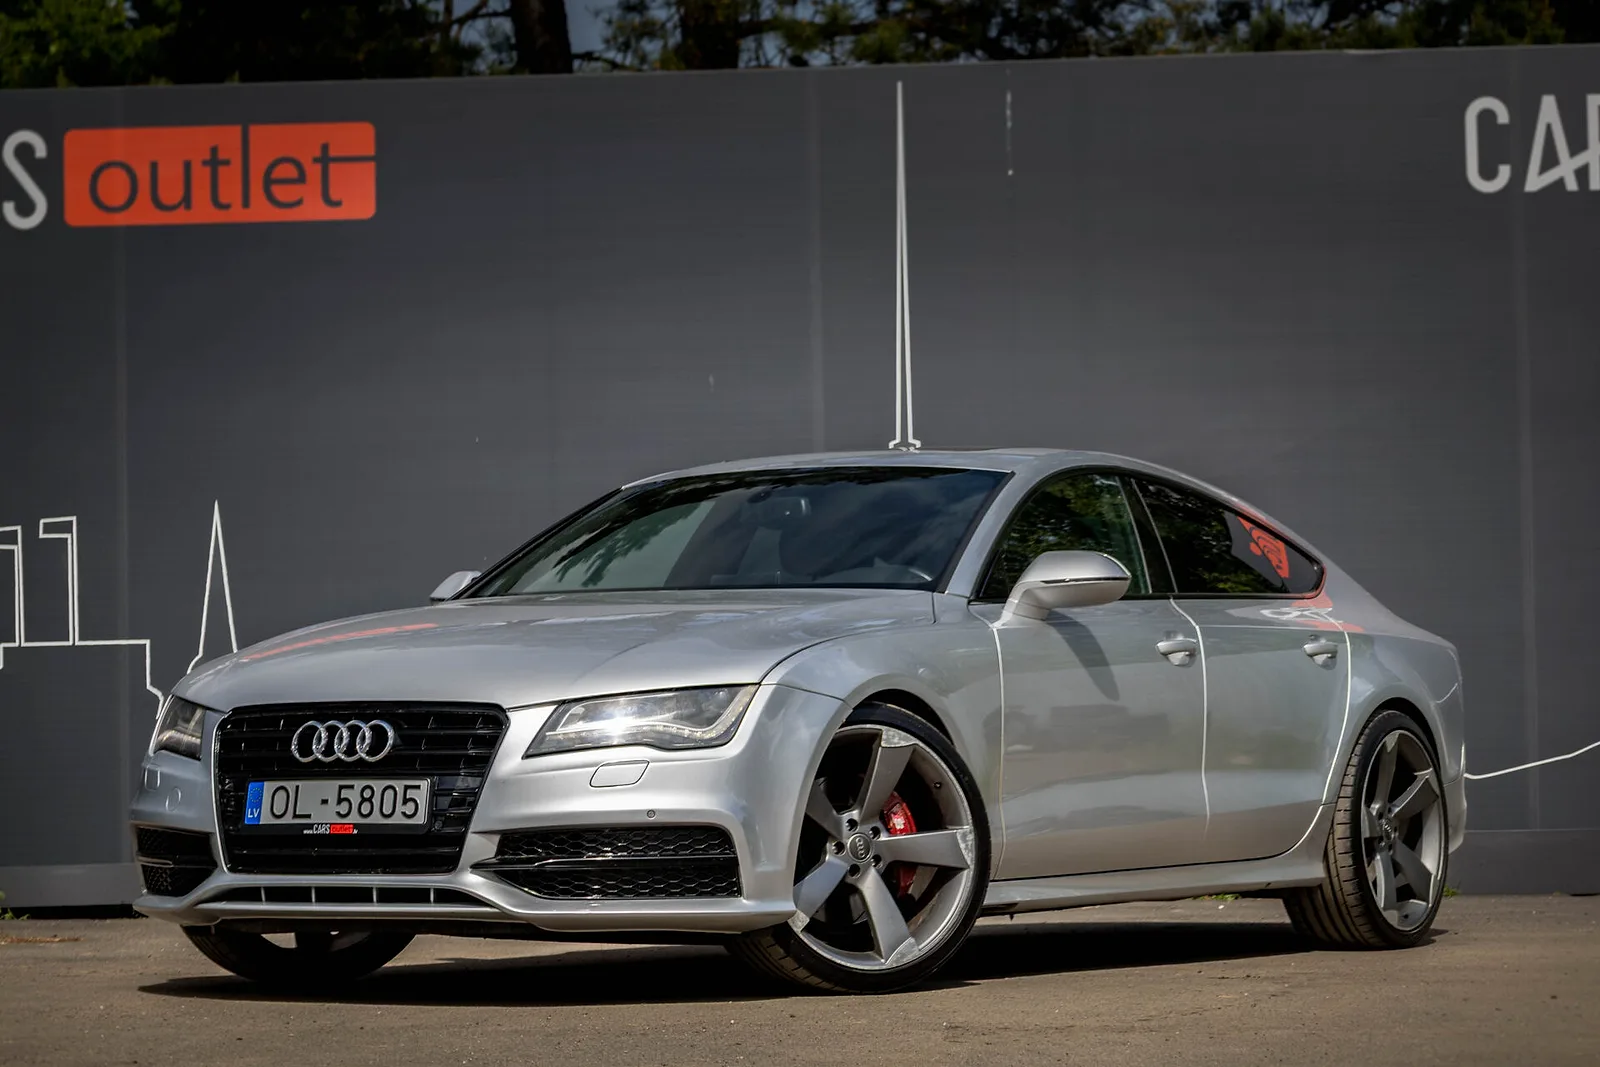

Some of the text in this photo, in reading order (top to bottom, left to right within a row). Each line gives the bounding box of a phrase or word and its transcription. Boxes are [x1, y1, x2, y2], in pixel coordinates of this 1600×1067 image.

[2, 125, 376, 230] S outlet
[247, 808, 260, 818] LV
